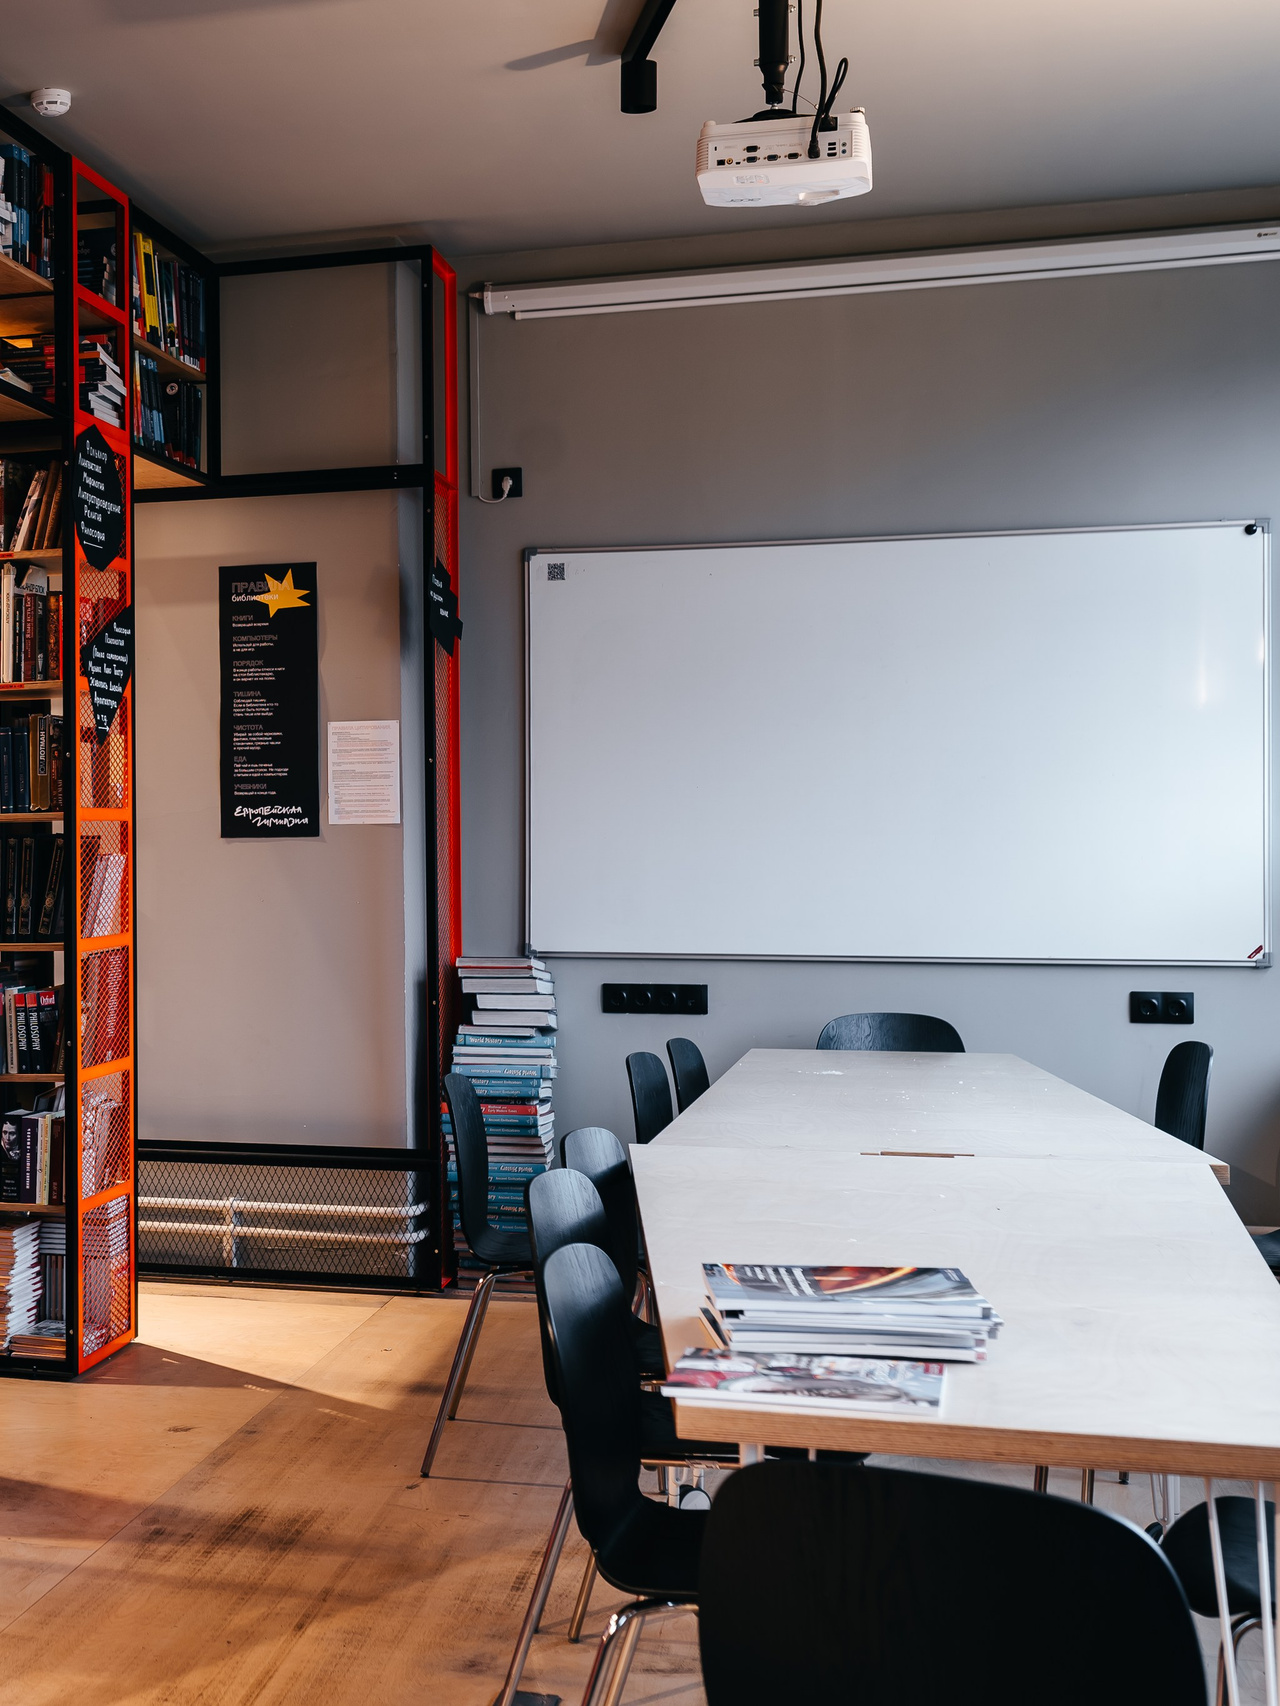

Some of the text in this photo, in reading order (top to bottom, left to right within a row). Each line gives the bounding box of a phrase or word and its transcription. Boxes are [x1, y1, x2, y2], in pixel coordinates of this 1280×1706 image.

[86, 440, 108, 464] Фольклор
[231, 580, 291, 593] ПРАВИЛА
[231, 593, 279, 602] библиотеки
[39, 993, 56, 1005] Oxford
[18, 1012, 27, 1051] PHILOSOPHY
[30, 1012, 40, 1051] PHILOSOPHY
